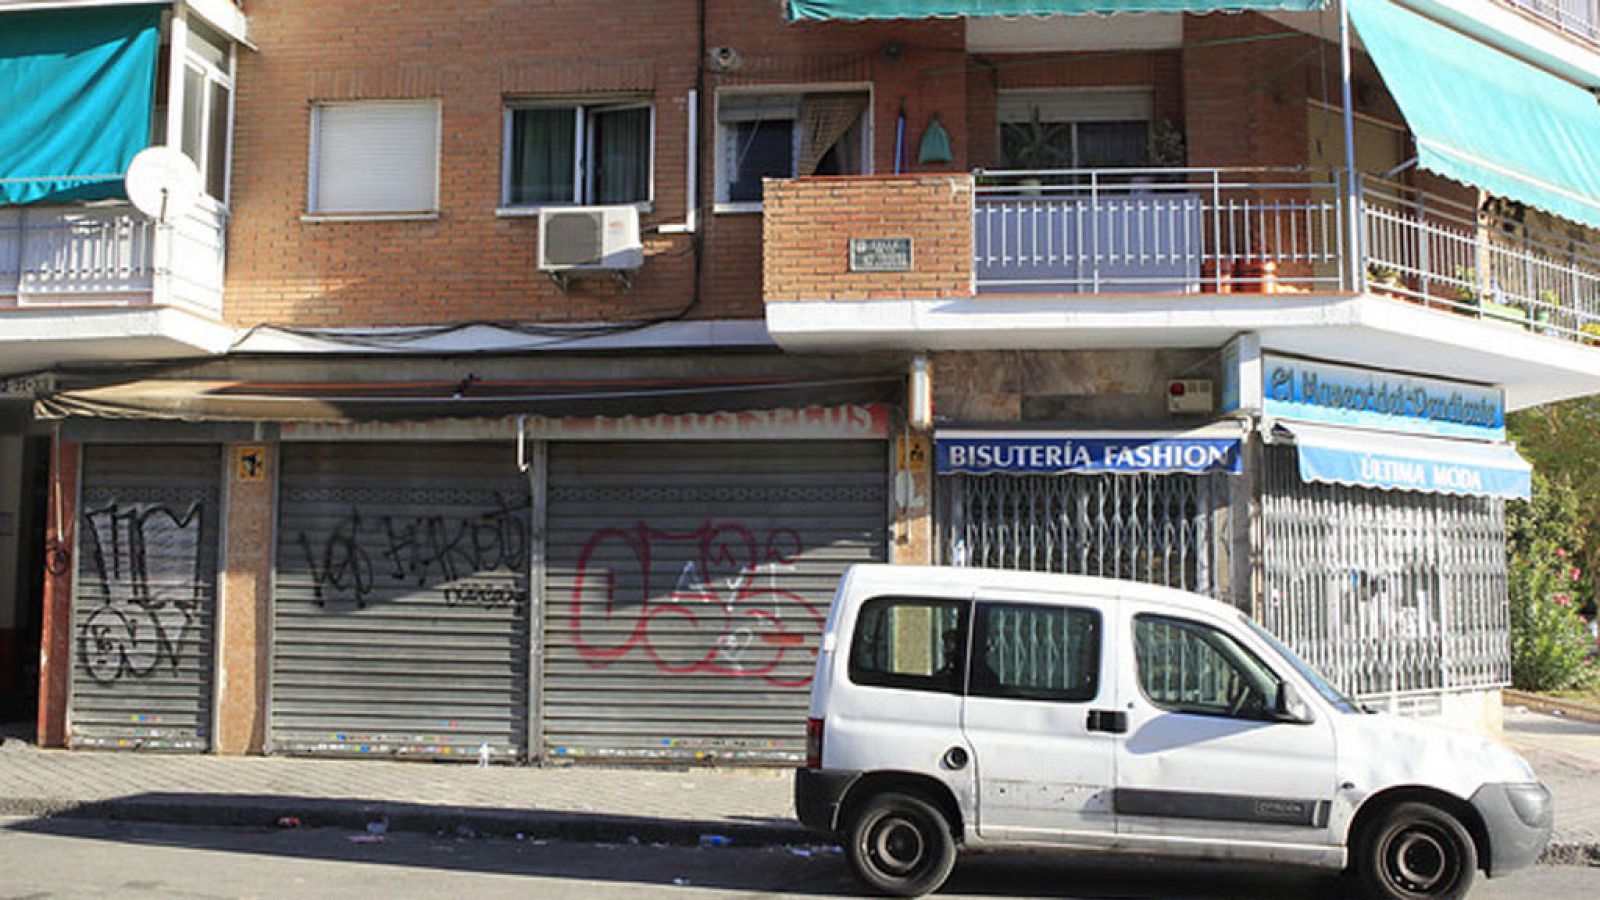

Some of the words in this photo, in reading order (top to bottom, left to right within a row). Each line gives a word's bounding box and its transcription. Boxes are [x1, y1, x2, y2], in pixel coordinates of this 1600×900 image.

[950, 440, 1091, 467] BISUTERÍA
[1103, 445, 1229, 466] FASHION
[1361, 452, 1426, 486] ÚLTIMA
[1433, 469, 1482, 490] MODA
